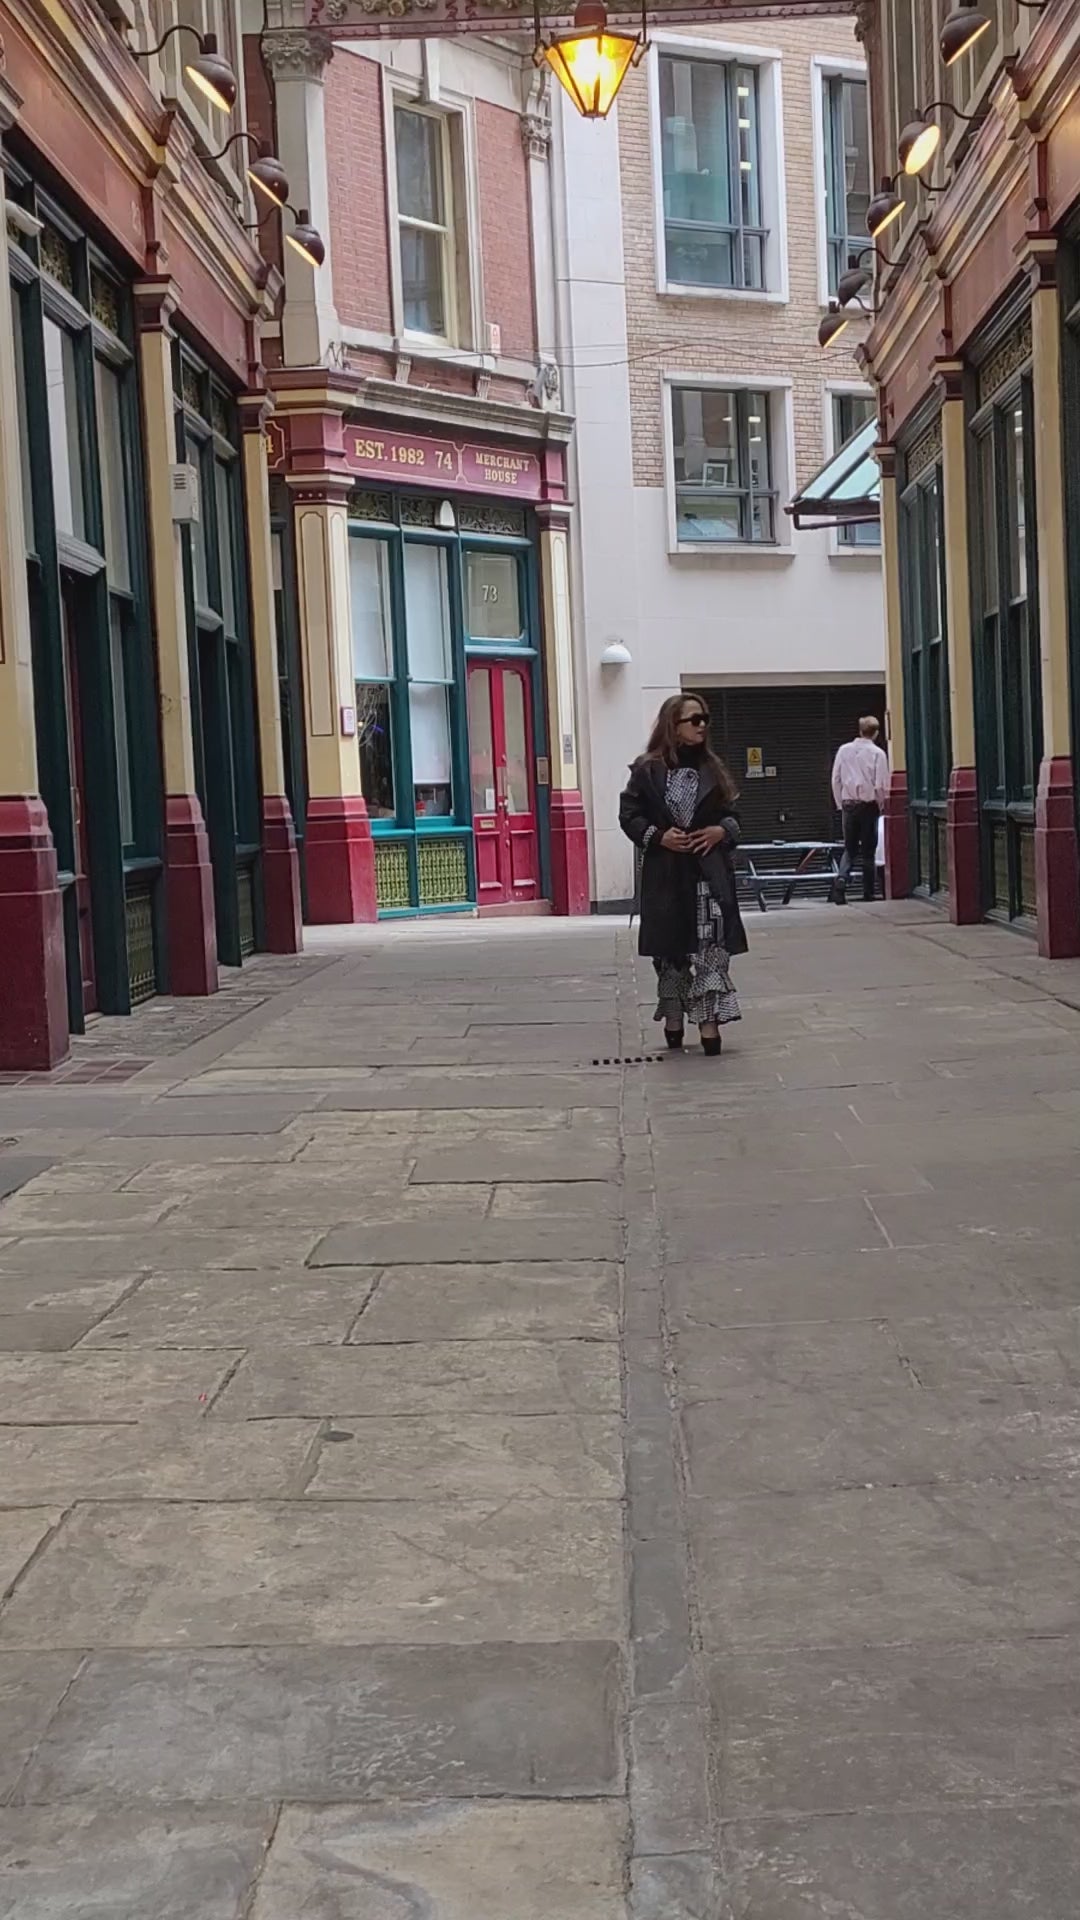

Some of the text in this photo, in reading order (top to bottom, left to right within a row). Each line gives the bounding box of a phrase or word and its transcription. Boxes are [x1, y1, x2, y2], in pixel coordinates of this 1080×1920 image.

[354, 439, 453, 470] EST. 1982 74
[475, 452, 529, 471] MERCHANT
[484, 468, 517, 485] HOUSE
[482, 585, 498, 602] 73
